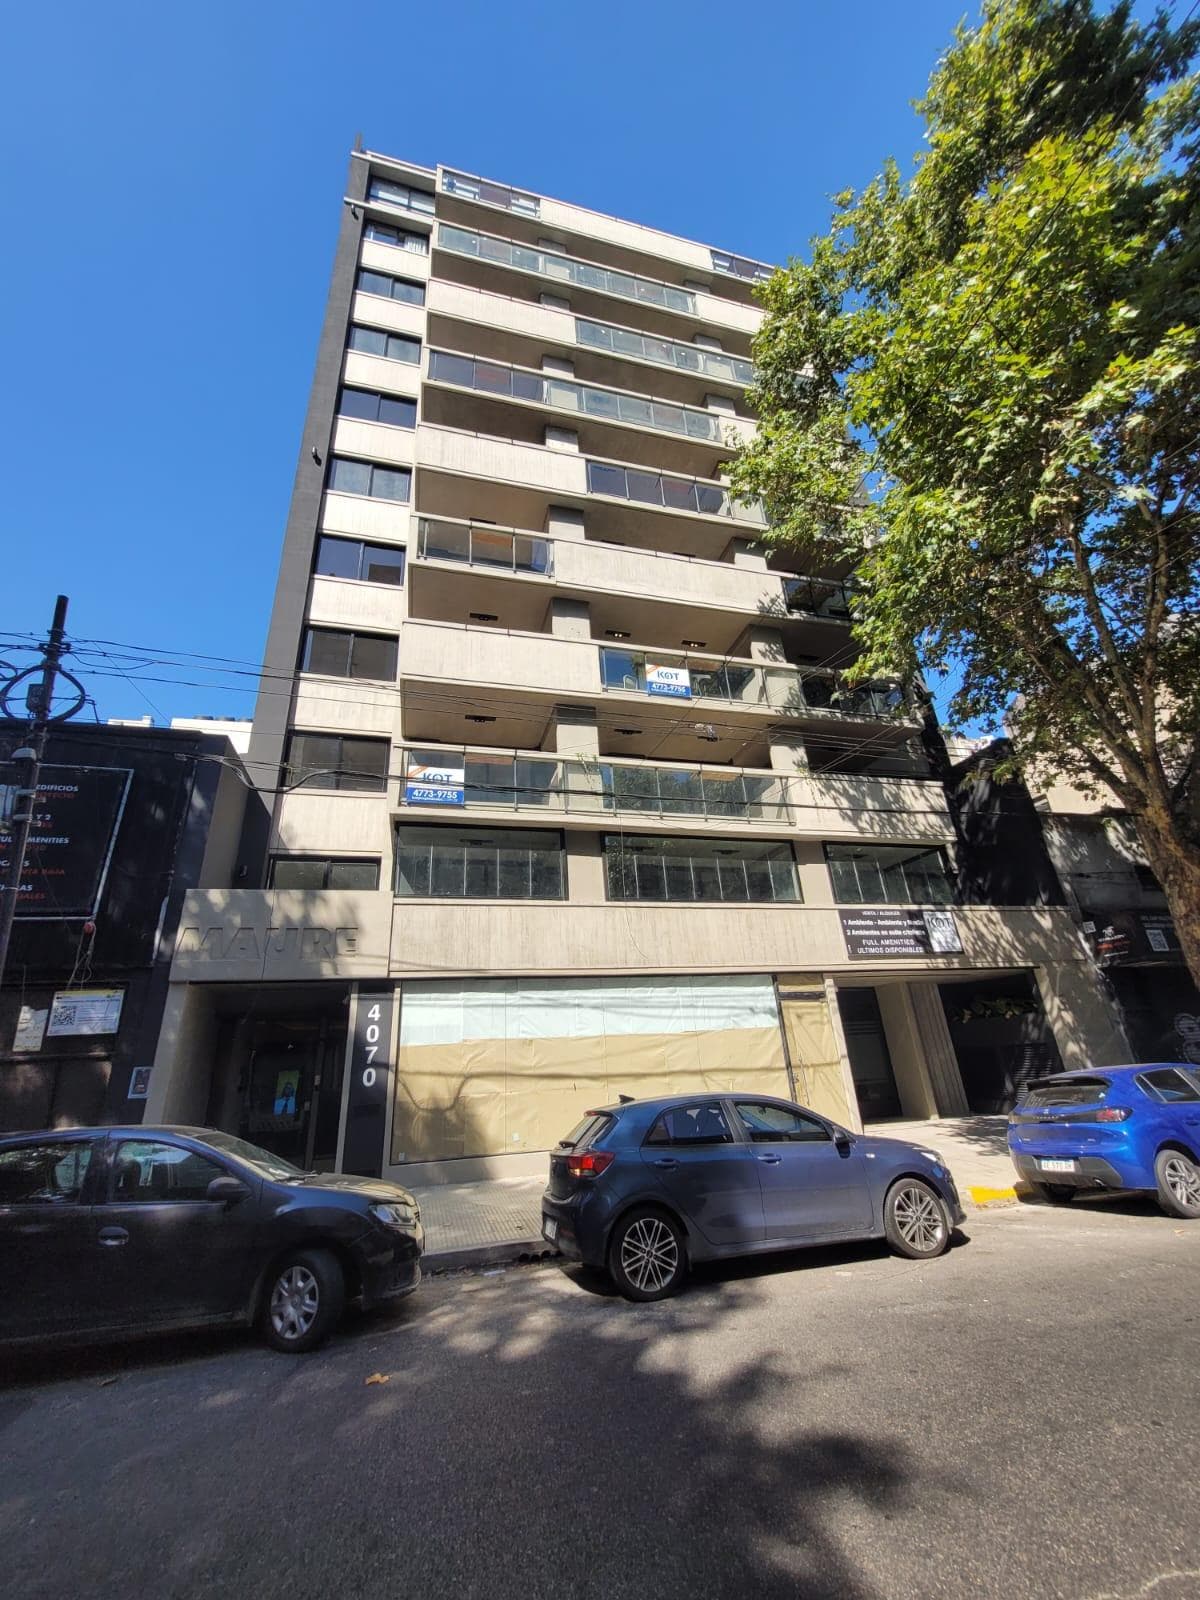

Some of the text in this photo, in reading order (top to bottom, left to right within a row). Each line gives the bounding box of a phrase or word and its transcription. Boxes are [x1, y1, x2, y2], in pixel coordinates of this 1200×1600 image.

[657, 671, 680, 681] KOT
[423, 772, 454, 785] KOT
[412, 788, 458, 799] 4773-9755
[27, 836, 70, 844] MENITIES
[880, 938, 915, 946] AMENITIES
[362, 1003, 382, 1088] 4070
